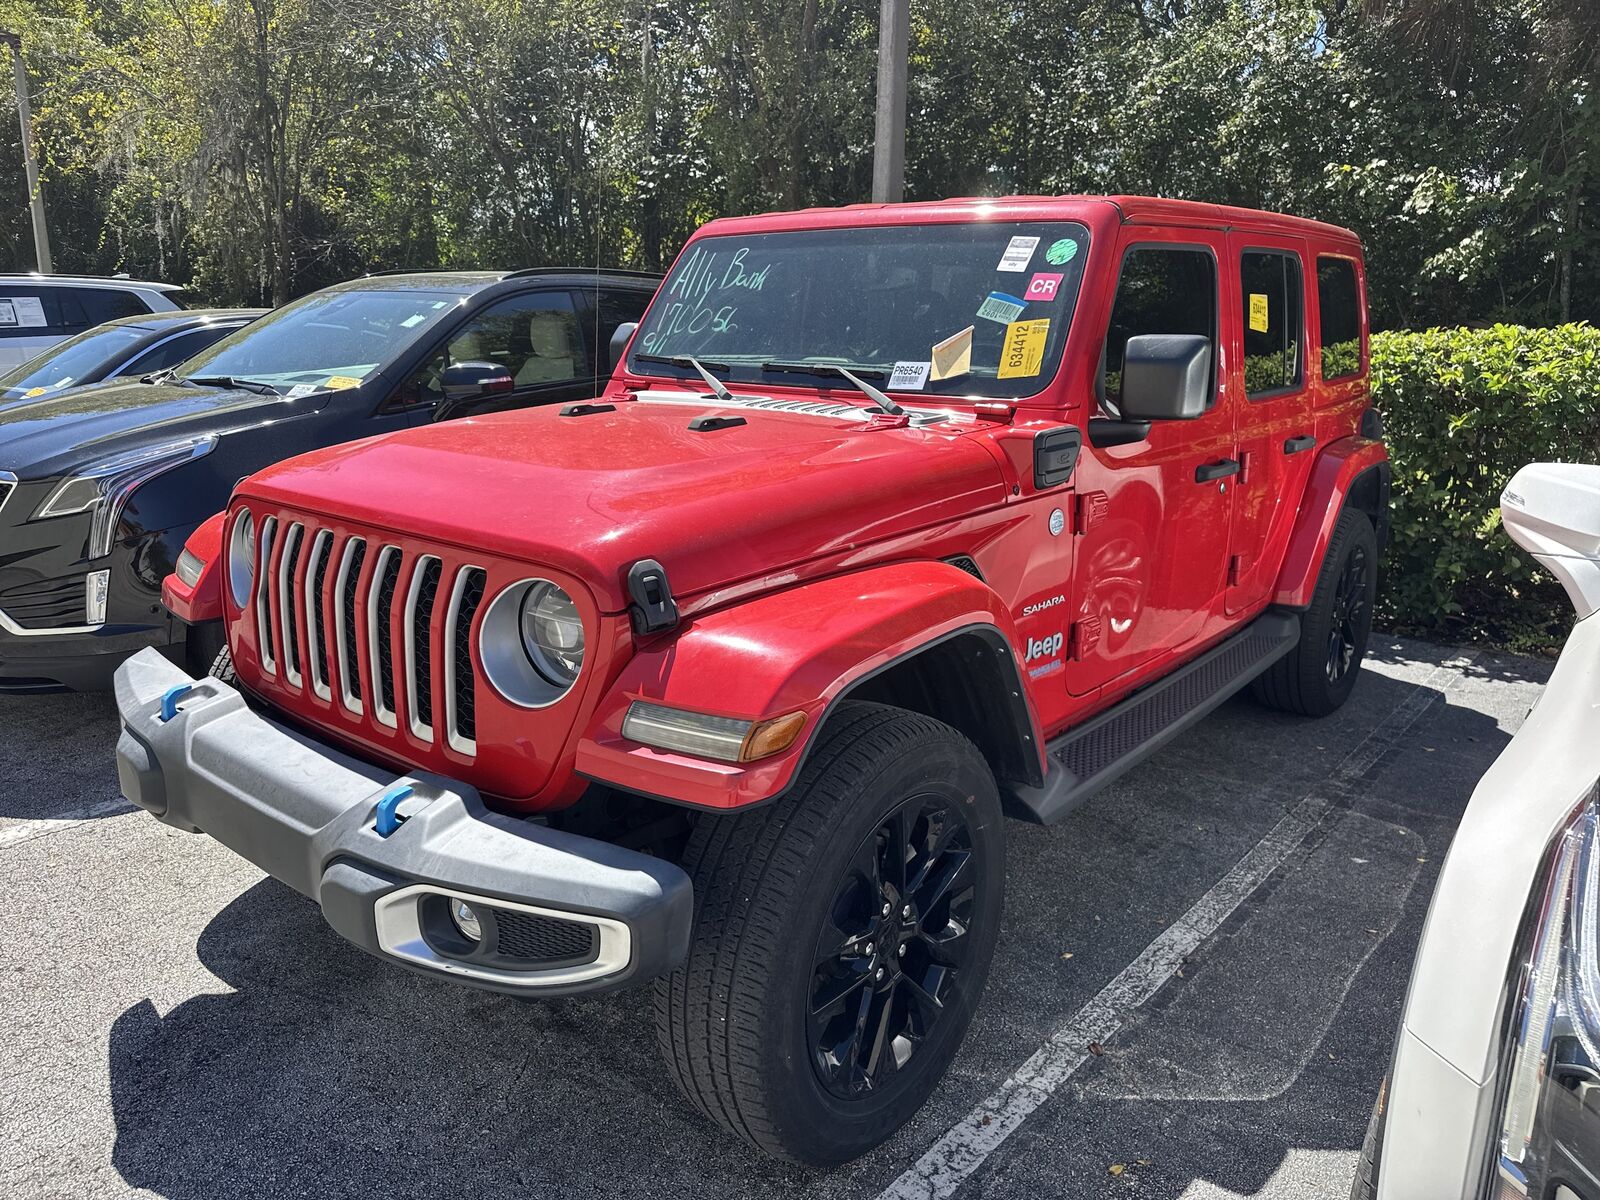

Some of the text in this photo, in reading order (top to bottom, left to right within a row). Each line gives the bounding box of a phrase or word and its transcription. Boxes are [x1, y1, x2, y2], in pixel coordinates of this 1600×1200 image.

[669, 246, 771, 314] Ally Bank
[1030, 279, 1056, 294] CR
[1009, 325, 1030, 368] 634412
[893, 366, 924, 376] PR6540
[1023, 594, 1066, 617] SAHARA
[1024, 632, 1063, 663] Jeep
